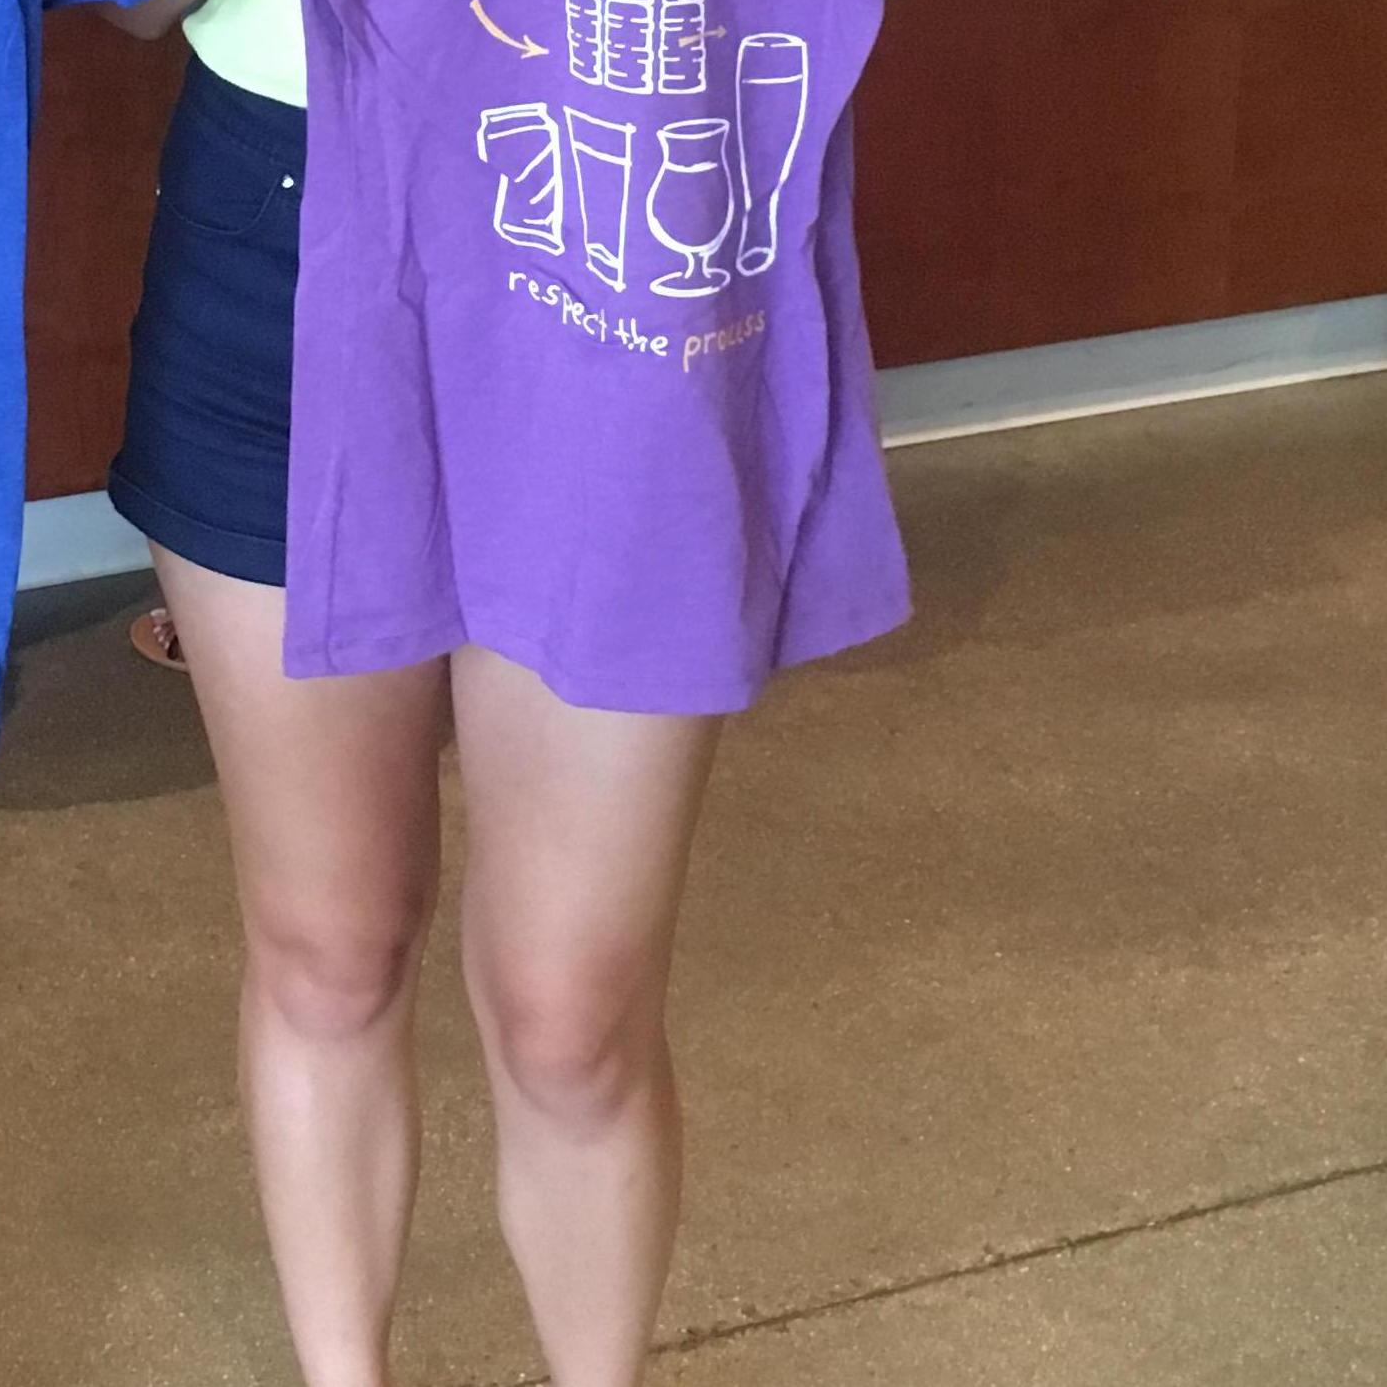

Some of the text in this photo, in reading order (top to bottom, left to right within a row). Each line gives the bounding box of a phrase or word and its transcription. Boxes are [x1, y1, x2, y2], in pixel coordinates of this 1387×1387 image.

[508, 270, 766, 373] respect the process
